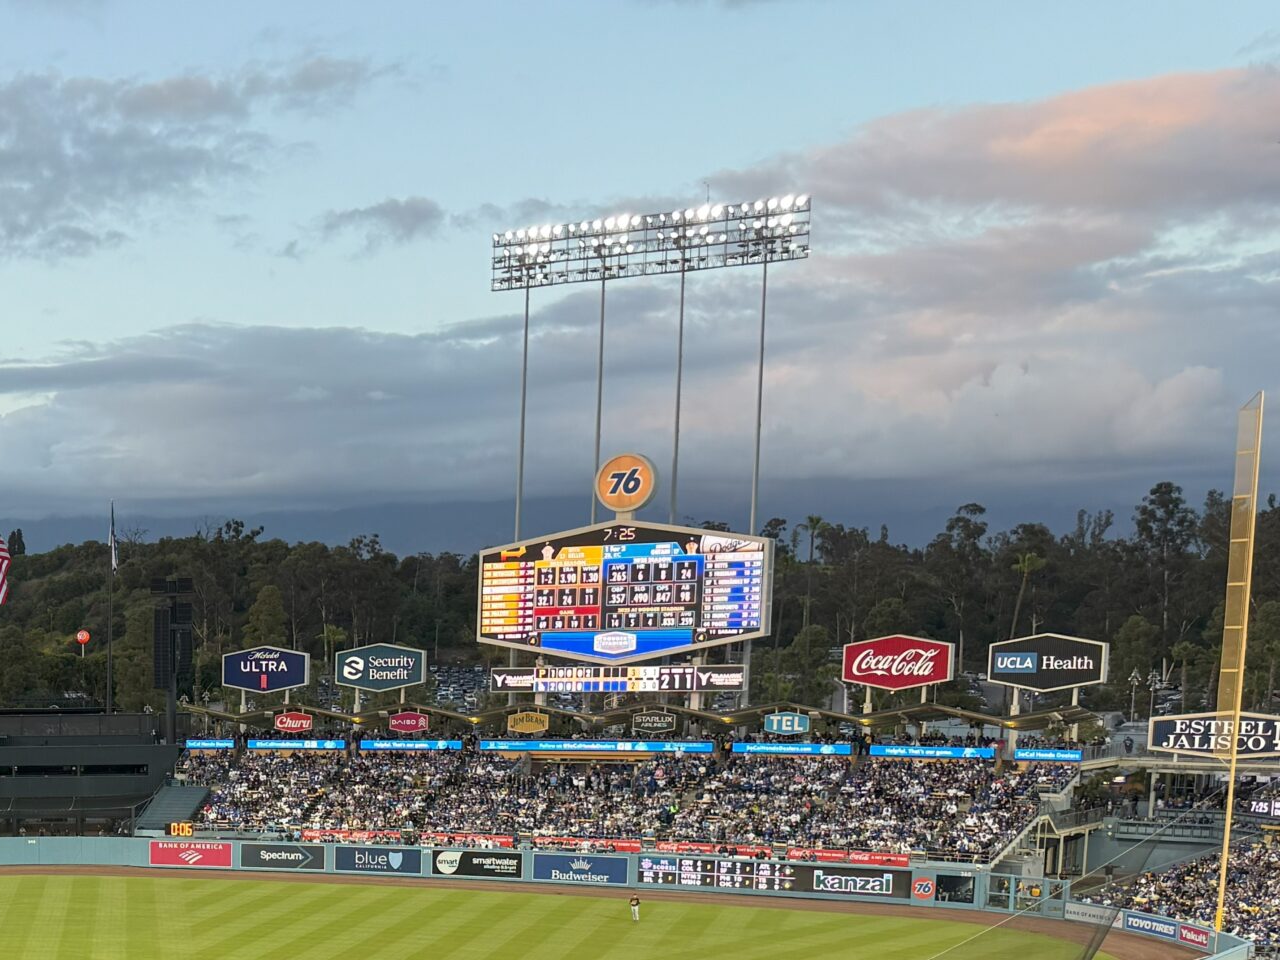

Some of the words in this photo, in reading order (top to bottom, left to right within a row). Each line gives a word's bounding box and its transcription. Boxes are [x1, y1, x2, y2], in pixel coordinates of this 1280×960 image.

[608, 468, 642, 496] 76
[604, 528, 635, 541] 7:25
[541, 574, 553, 583] 1-2
[560, 574, 576, 583] 3.90
[582, 573, 598, 582] 1.30
[610, 572, 626, 581] .265
[681, 569, 691, 578] 24
[538, 596, 553, 605] 32.1
[562, 596, 572, 605] 24
[585, 595, 593, 604] 11
[609, 594, 625, 603] .357
[631, 593, 648, 603] .490
[654, 592, 671, 602] .847
[248, 651, 280, 659] Michelob
[240, 661, 288, 672] ULTRA
[368, 655, 415, 670] Security
[851, 648, 940, 677] Coca-Cola
[997, 657, 1034, 669] UCLA
[1041, 655, 1093, 671] Health
[369, 668, 408, 680] Benefit
[660, 675, 669, 689] 2
[686, 674, 691, 689] 1
[276, 716, 311, 728] Churu
[510, 717, 523, 728] JIM
[523, 715, 546, 728] BEAM
[635, 716, 675, 724] STARLUX
[769, 716, 803, 731] TEL
[1162, 735, 1266, 750] JALISCO
[885, 748, 906, 757] Helpful.
[909, 748, 925, 756] That's
[926, 748, 936, 756] our
[937, 748, 953, 757] game.
[1250, 801, 1269, 813] 7:25
[170, 822, 193, 836] 0:06
[260, 851, 303, 862] Spectrum
[355, 851, 387, 864] blue
[437, 858, 458, 866] smart
[472, 857, 518, 866] smartwater
[849, 853, 870, 861] Coca-Cola
[551, 870, 609, 881] Budweiser
[915, 882, 931, 894] 76
[1128, 916, 1151, 931] TOYO
[1151, 921, 1175, 936] TIRES
[1180, 927, 1208, 945] Yakult
